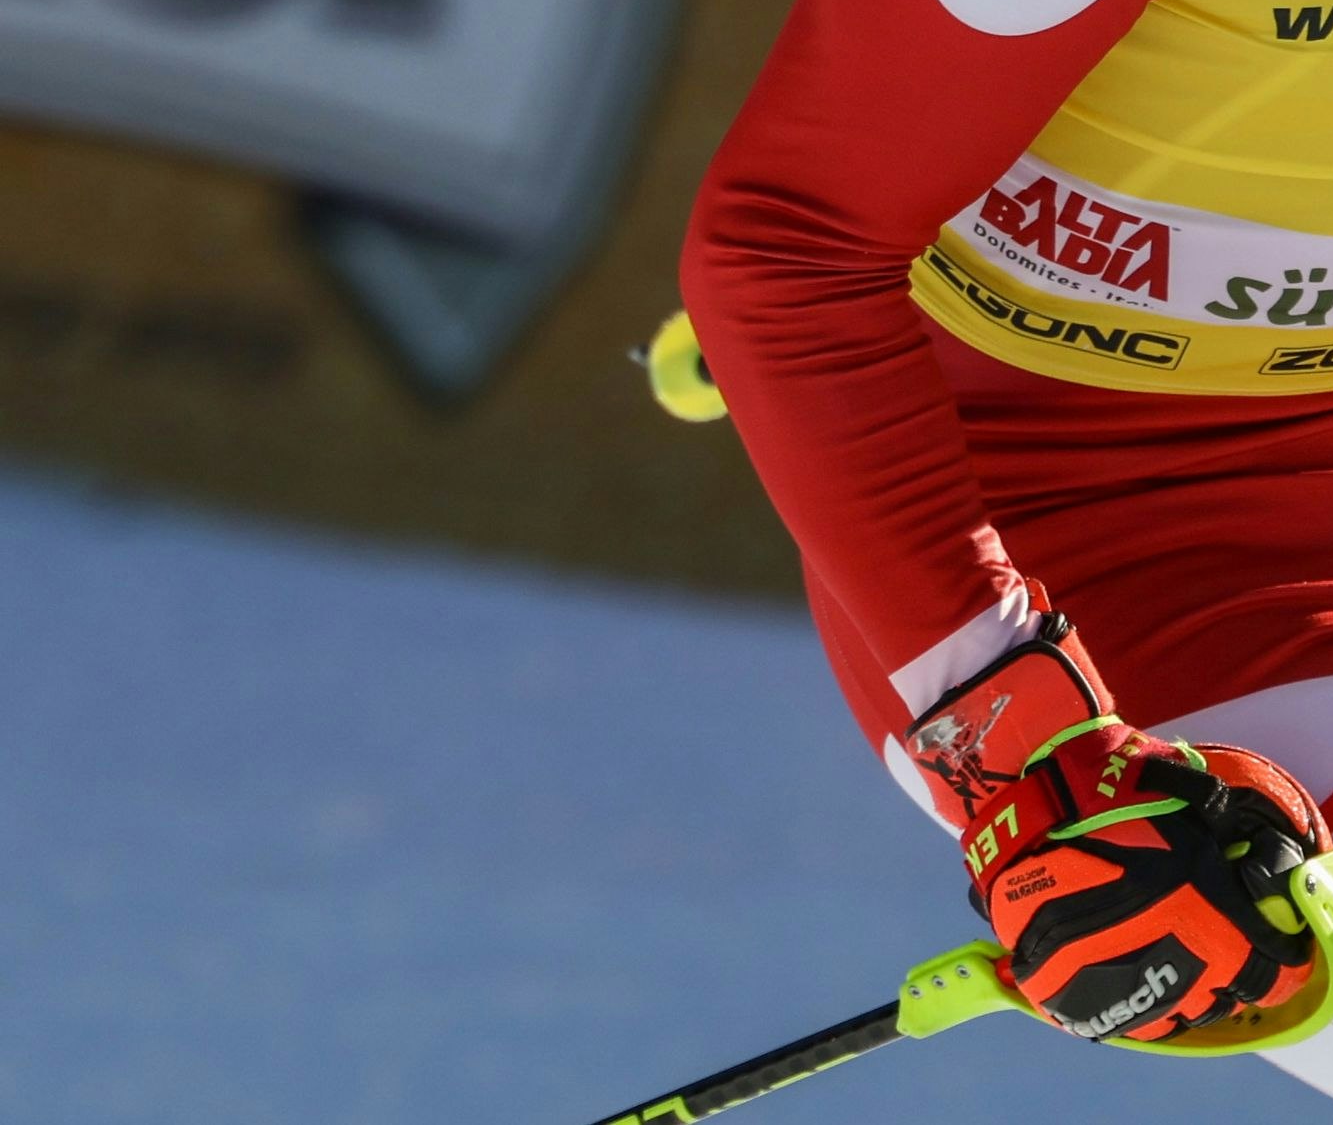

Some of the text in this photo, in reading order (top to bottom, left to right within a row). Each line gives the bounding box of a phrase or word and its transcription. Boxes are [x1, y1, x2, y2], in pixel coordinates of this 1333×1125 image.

[979, 187, 1171, 302] BADIA
[1013, 175, 1170, 253] ALTA
[974, 222, 1082, 291] Dolomites
[965, 802, 1019, 880] LEK
